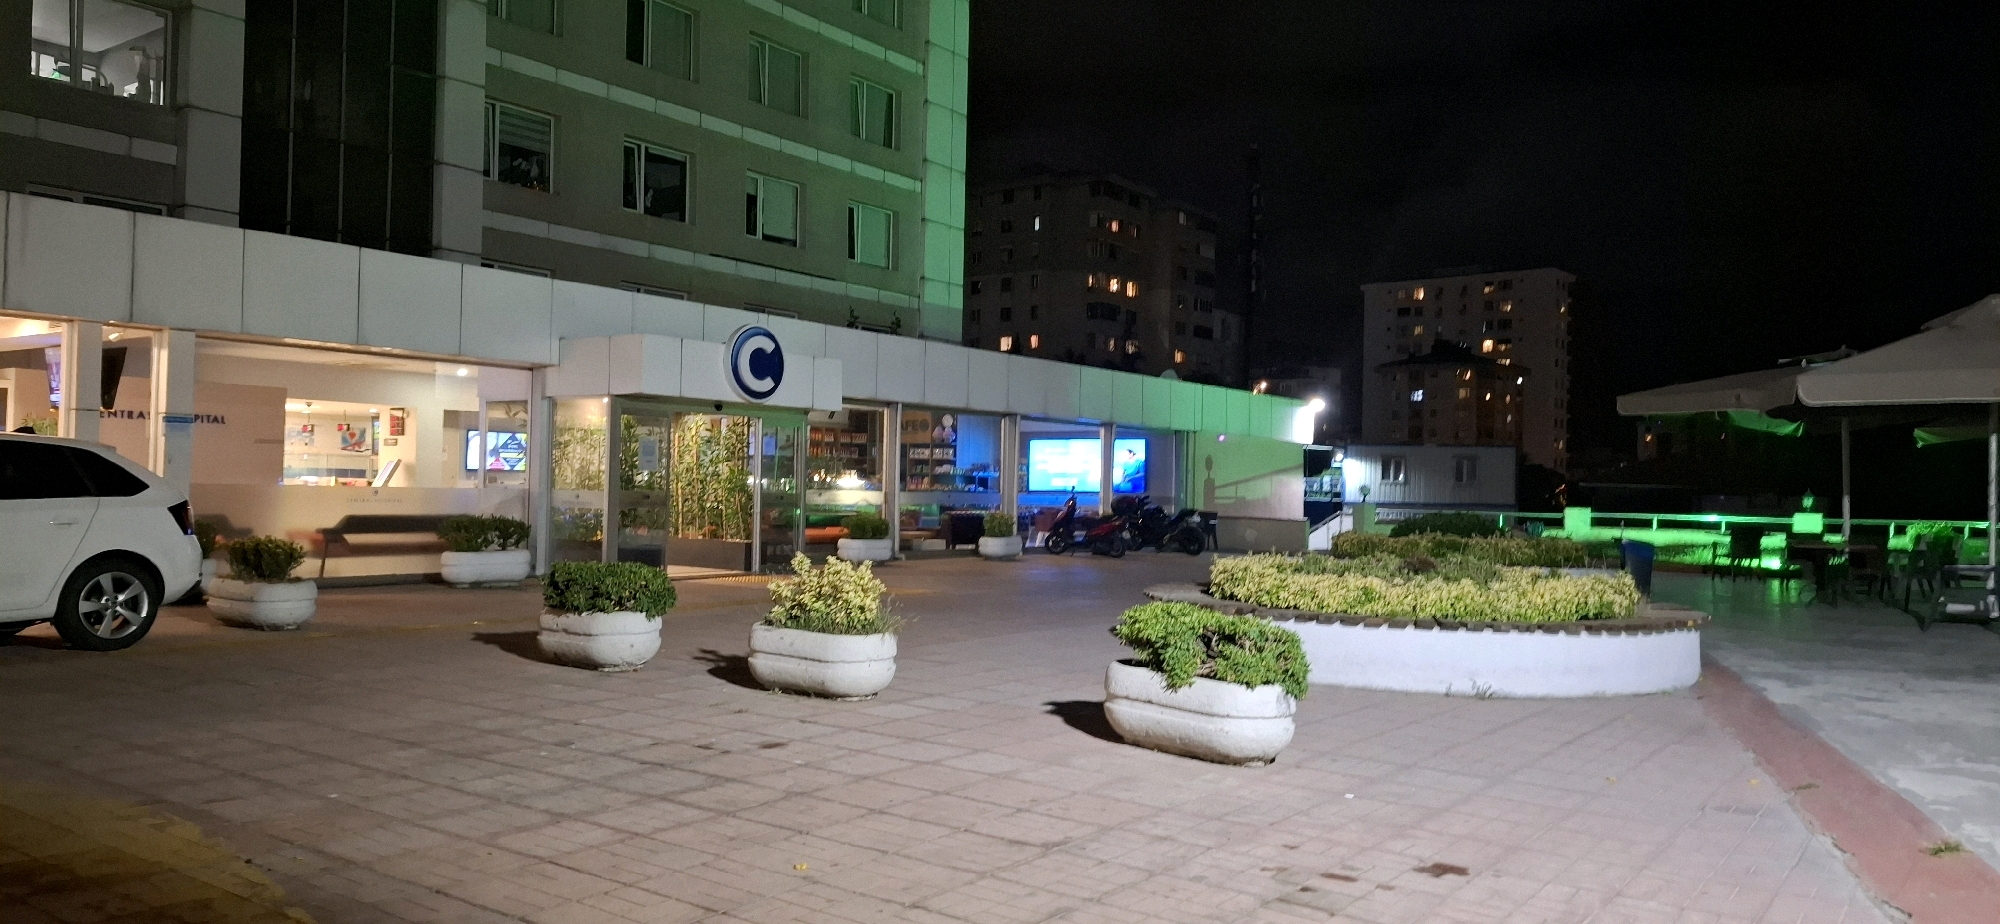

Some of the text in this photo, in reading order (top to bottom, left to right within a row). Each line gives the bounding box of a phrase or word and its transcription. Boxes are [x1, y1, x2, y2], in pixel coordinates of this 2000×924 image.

[737, 335, 776, 393] C
[99, 410, 151, 420] ENTRA
[193, 414, 226, 424] PITAL
